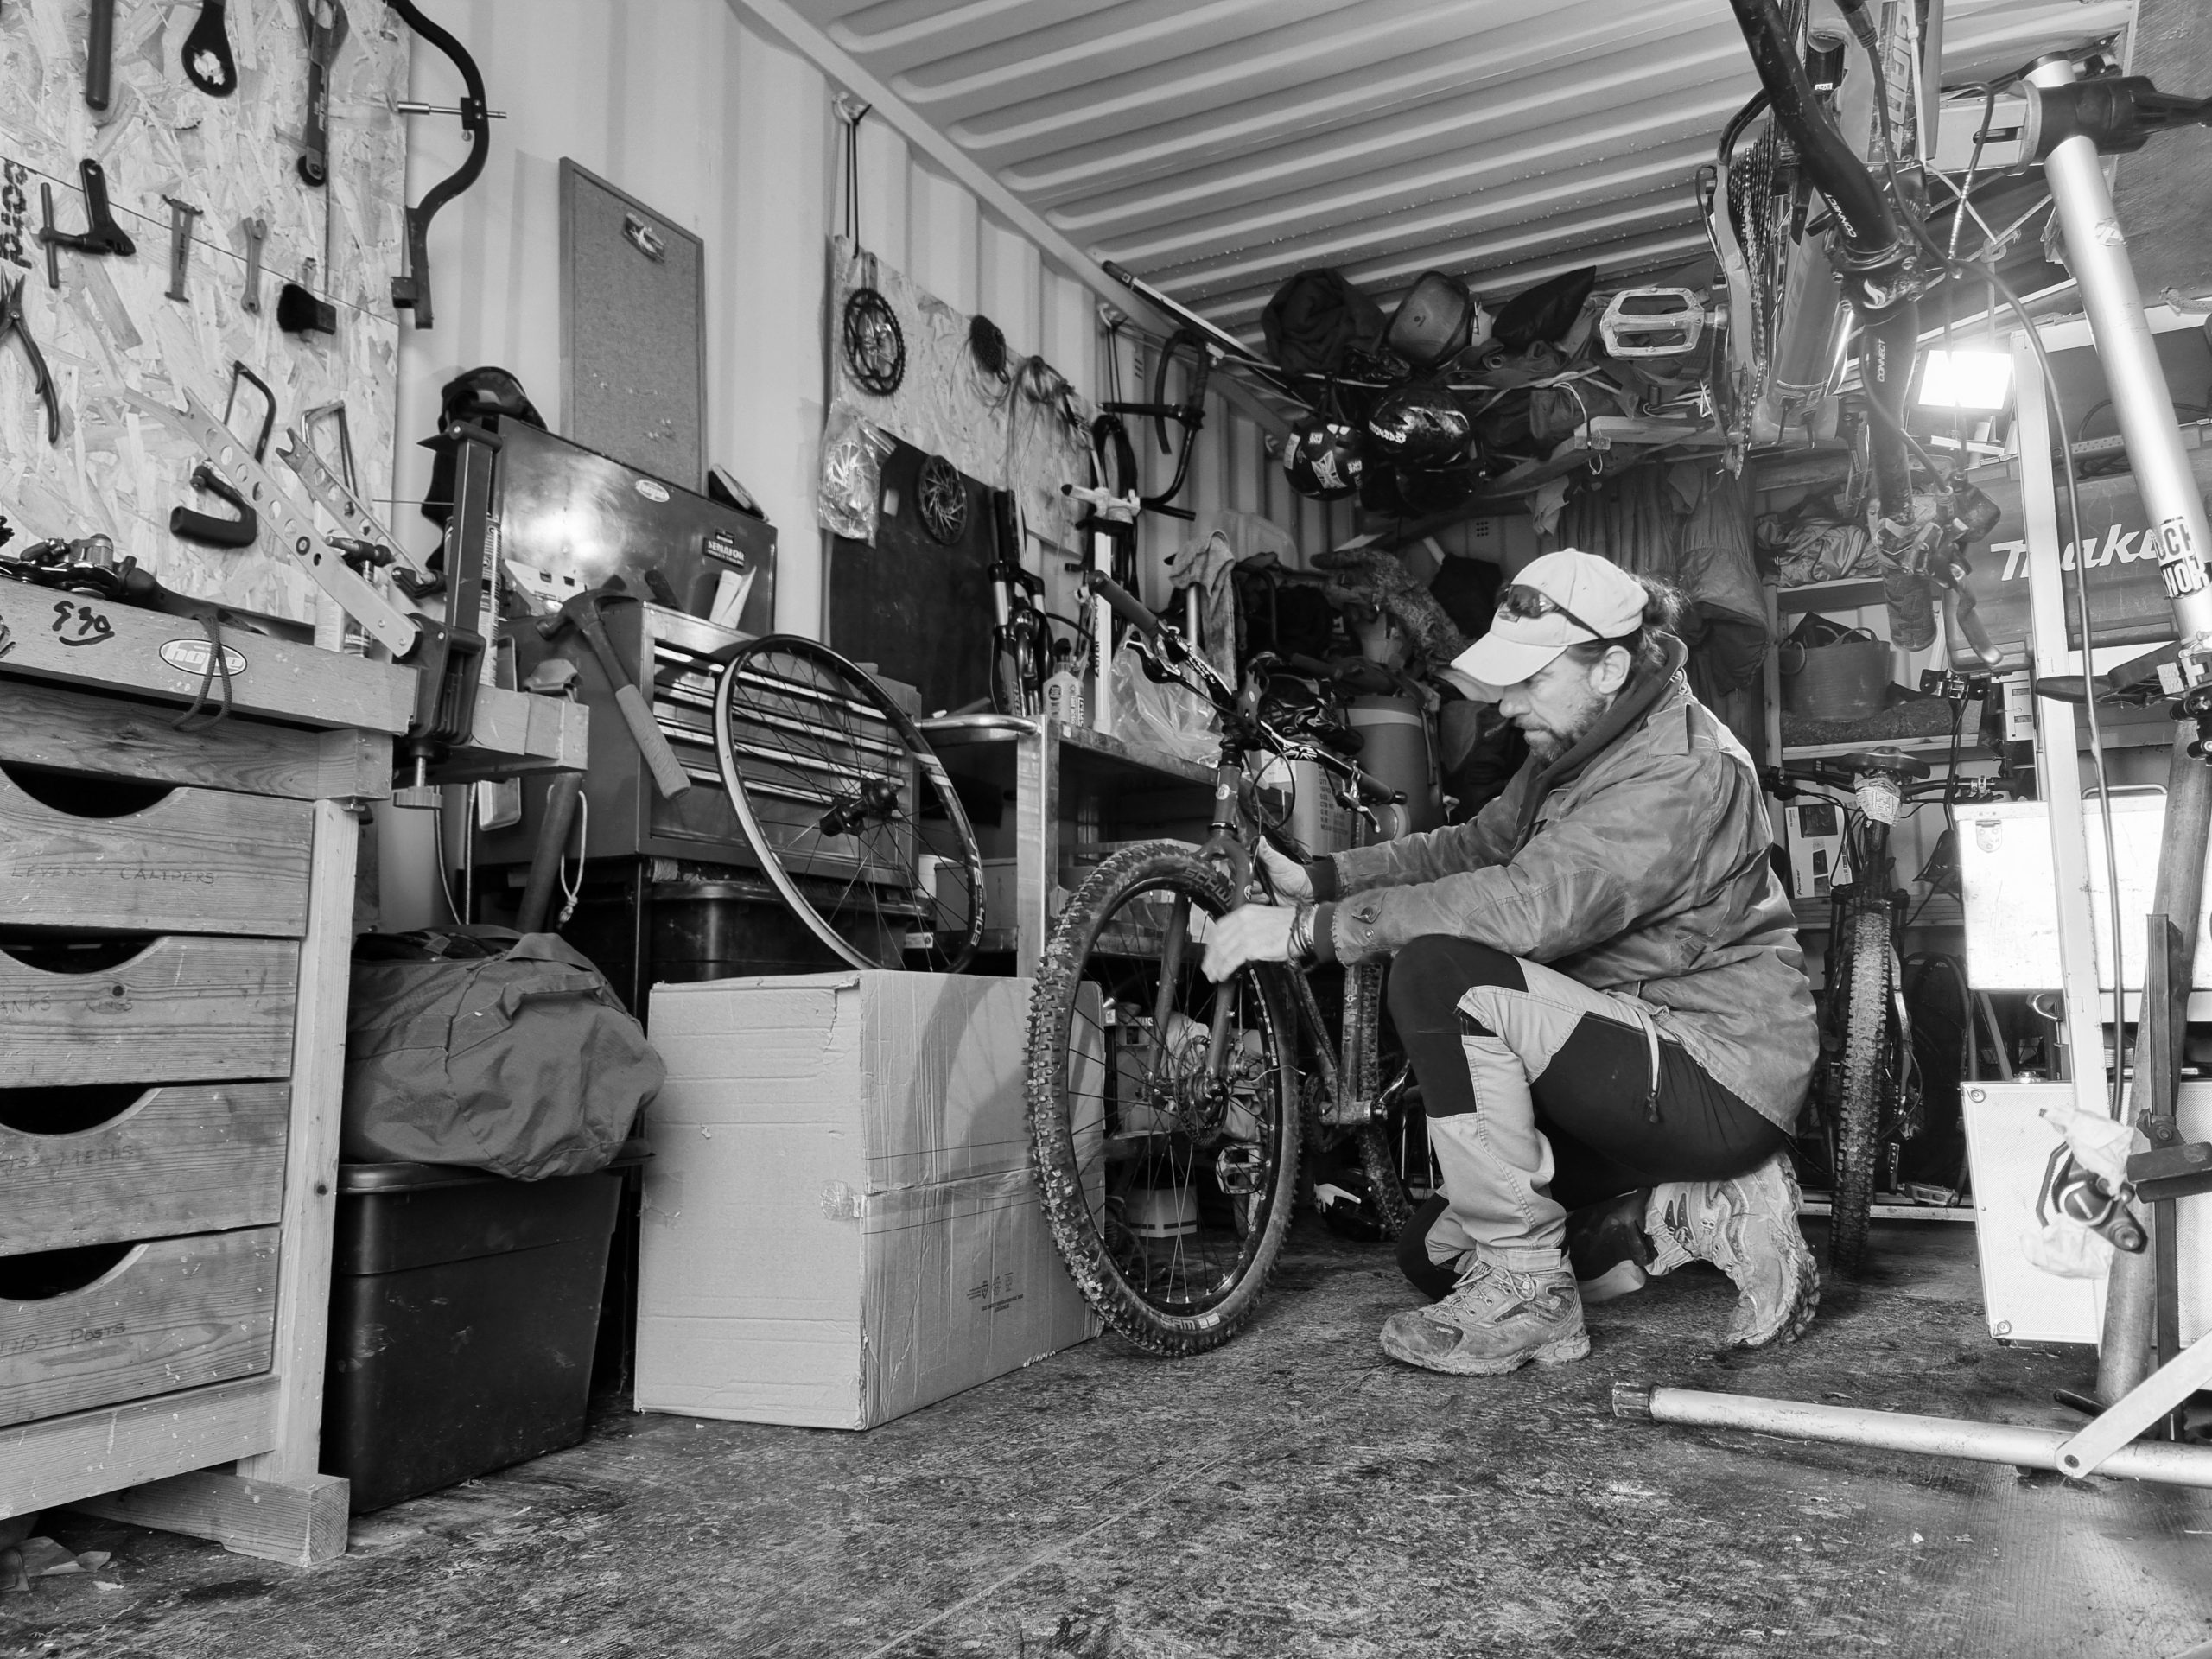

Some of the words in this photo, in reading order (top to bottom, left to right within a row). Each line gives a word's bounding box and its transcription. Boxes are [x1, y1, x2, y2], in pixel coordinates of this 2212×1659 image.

[1823, 192, 1857, 238] CONNECT
[1877, 338, 1886, 382] CONNECT
[707, 539, 745, 562] SENATOR
[120, 866, 214, 885] CALIPERS
